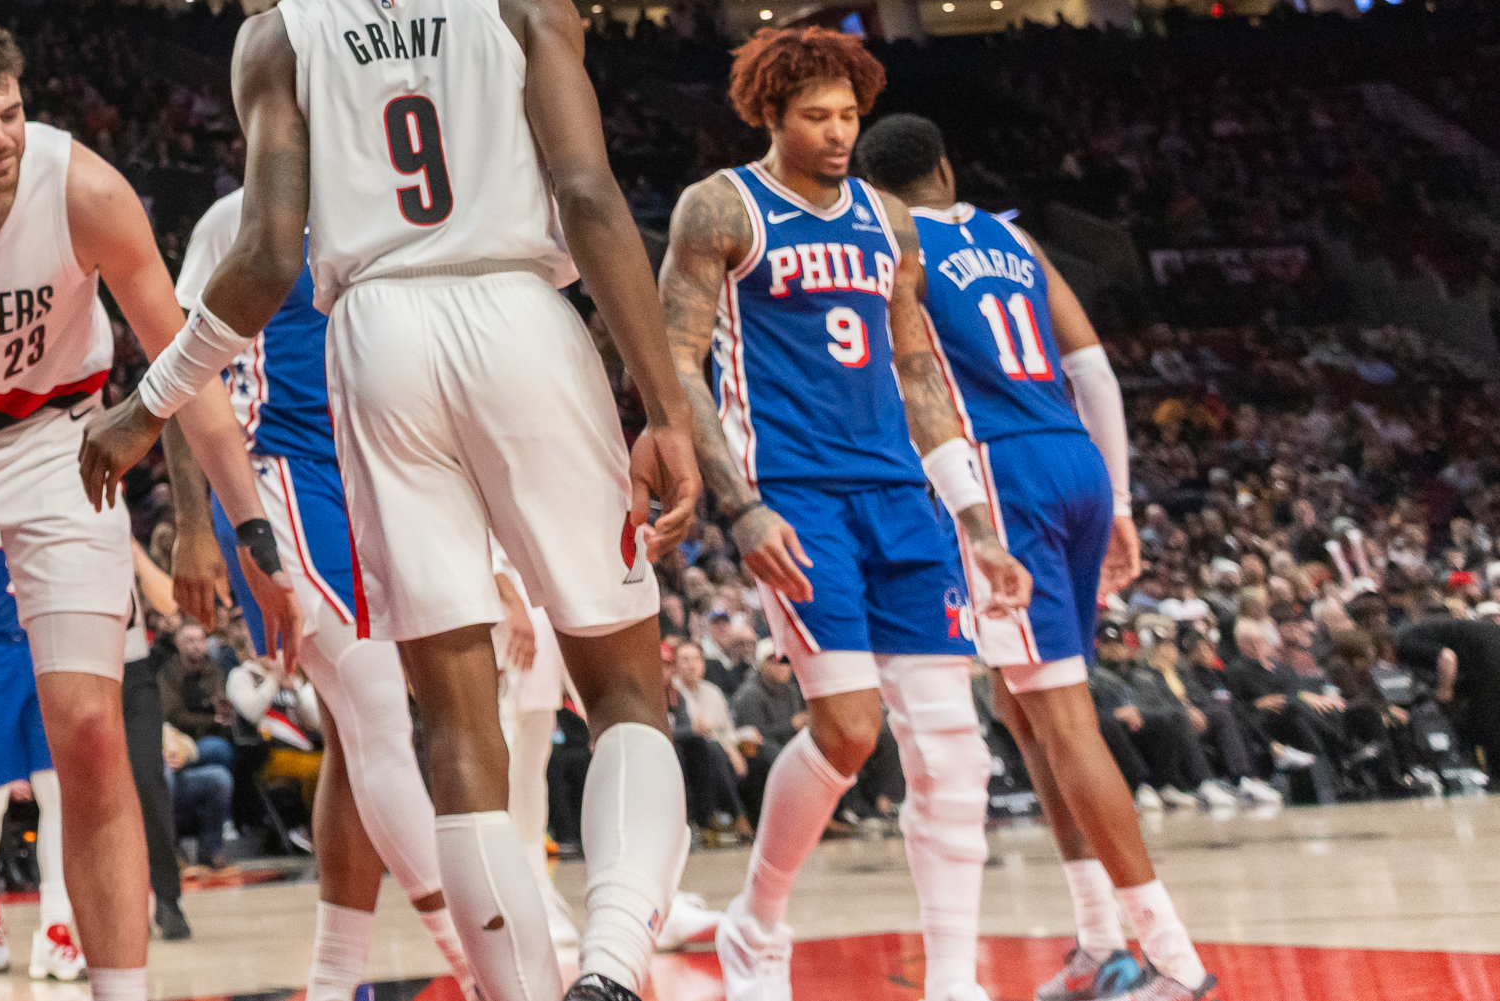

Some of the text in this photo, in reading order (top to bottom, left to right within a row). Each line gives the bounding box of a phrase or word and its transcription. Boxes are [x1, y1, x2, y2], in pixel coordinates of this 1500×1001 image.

[344, 17, 447, 65] GRANT
[384, 94, 454, 226] 9
[937, 247, 1035, 291] EDWARDS
[3, 324, 46, 380] 23
[825, 306, 870, 368] 9
[978, 292, 1055, 380] 11
